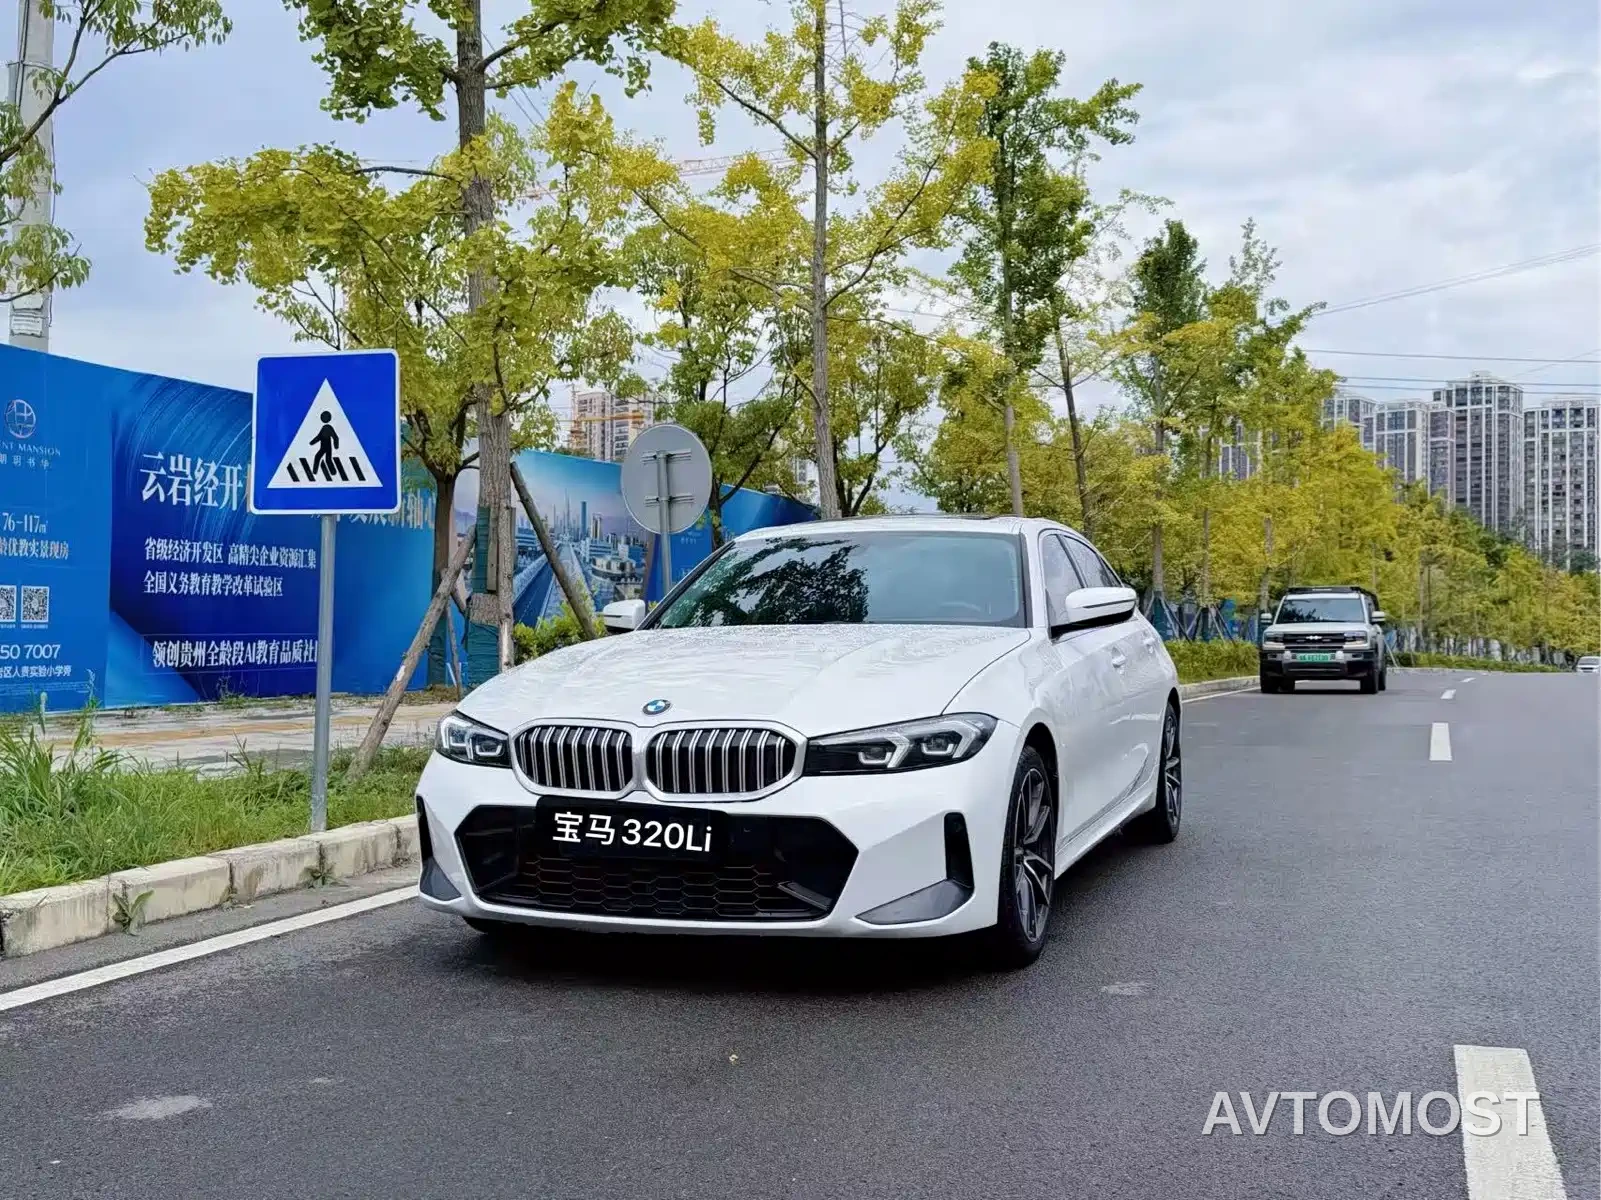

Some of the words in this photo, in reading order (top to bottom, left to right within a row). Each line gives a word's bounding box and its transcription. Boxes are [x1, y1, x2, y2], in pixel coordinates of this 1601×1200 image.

[18, 443, 61, 457] MANSION
[140, 451, 252, 513] 云岩经开
[144, 536, 224, 564] 省级经济开发区
[228, 543, 317, 569] 高精尖企业资源汇集
[143, 570, 284, 597] 全国义务教育教学改革试验区
[23, 644, 61, 660] 7007
[153, 639, 319, 668] 领创贵州全龄段AI教育品质社
[552, 811, 616, 846] 宝马
[621, 818, 713, 853] 320Li
